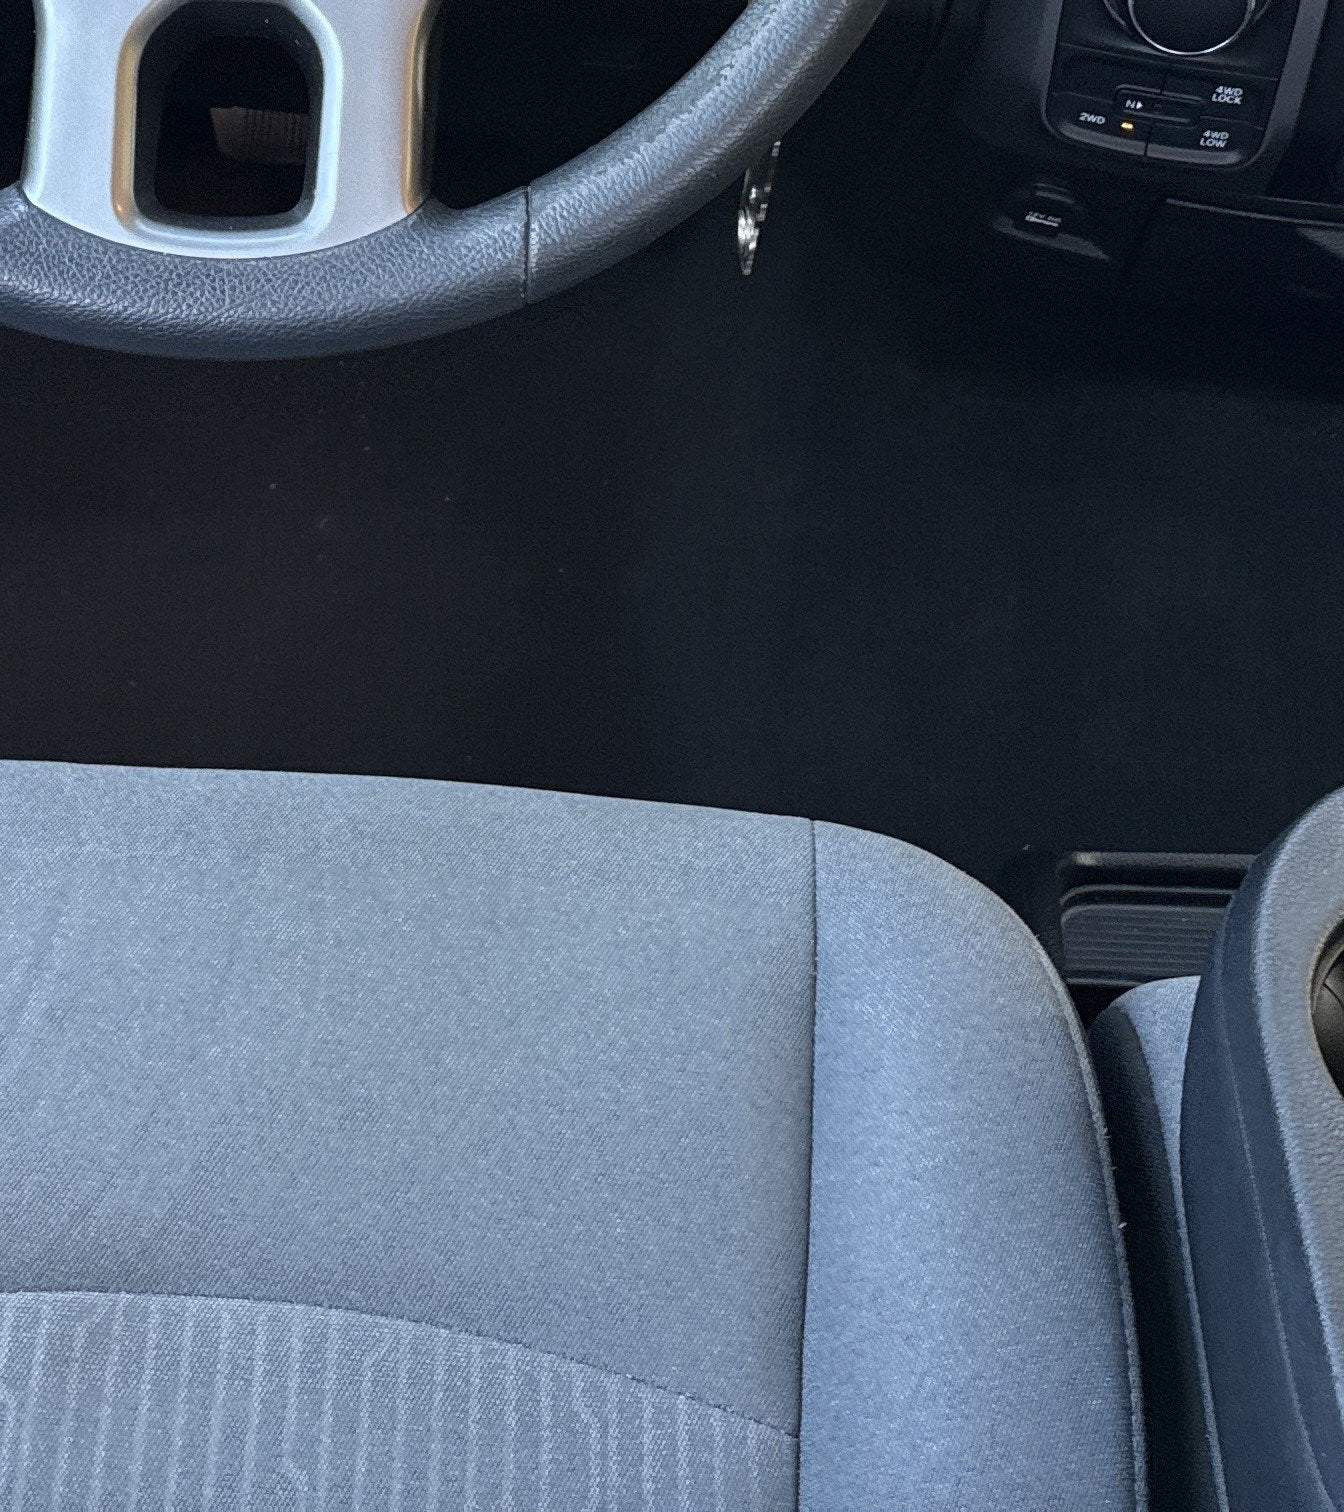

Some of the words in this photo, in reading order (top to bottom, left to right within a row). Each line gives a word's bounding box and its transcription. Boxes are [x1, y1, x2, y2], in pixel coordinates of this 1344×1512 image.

[1215, 85, 1244, 97] 4WD
[1125, 99, 1136, 109] N
[1211, 94, 1243, 105] LOCK
[1079, 112, 1106, 125] 2WD
[1202, 129, 1229, 140] 4WD
[1199, 137, 1228, 148] LOW
